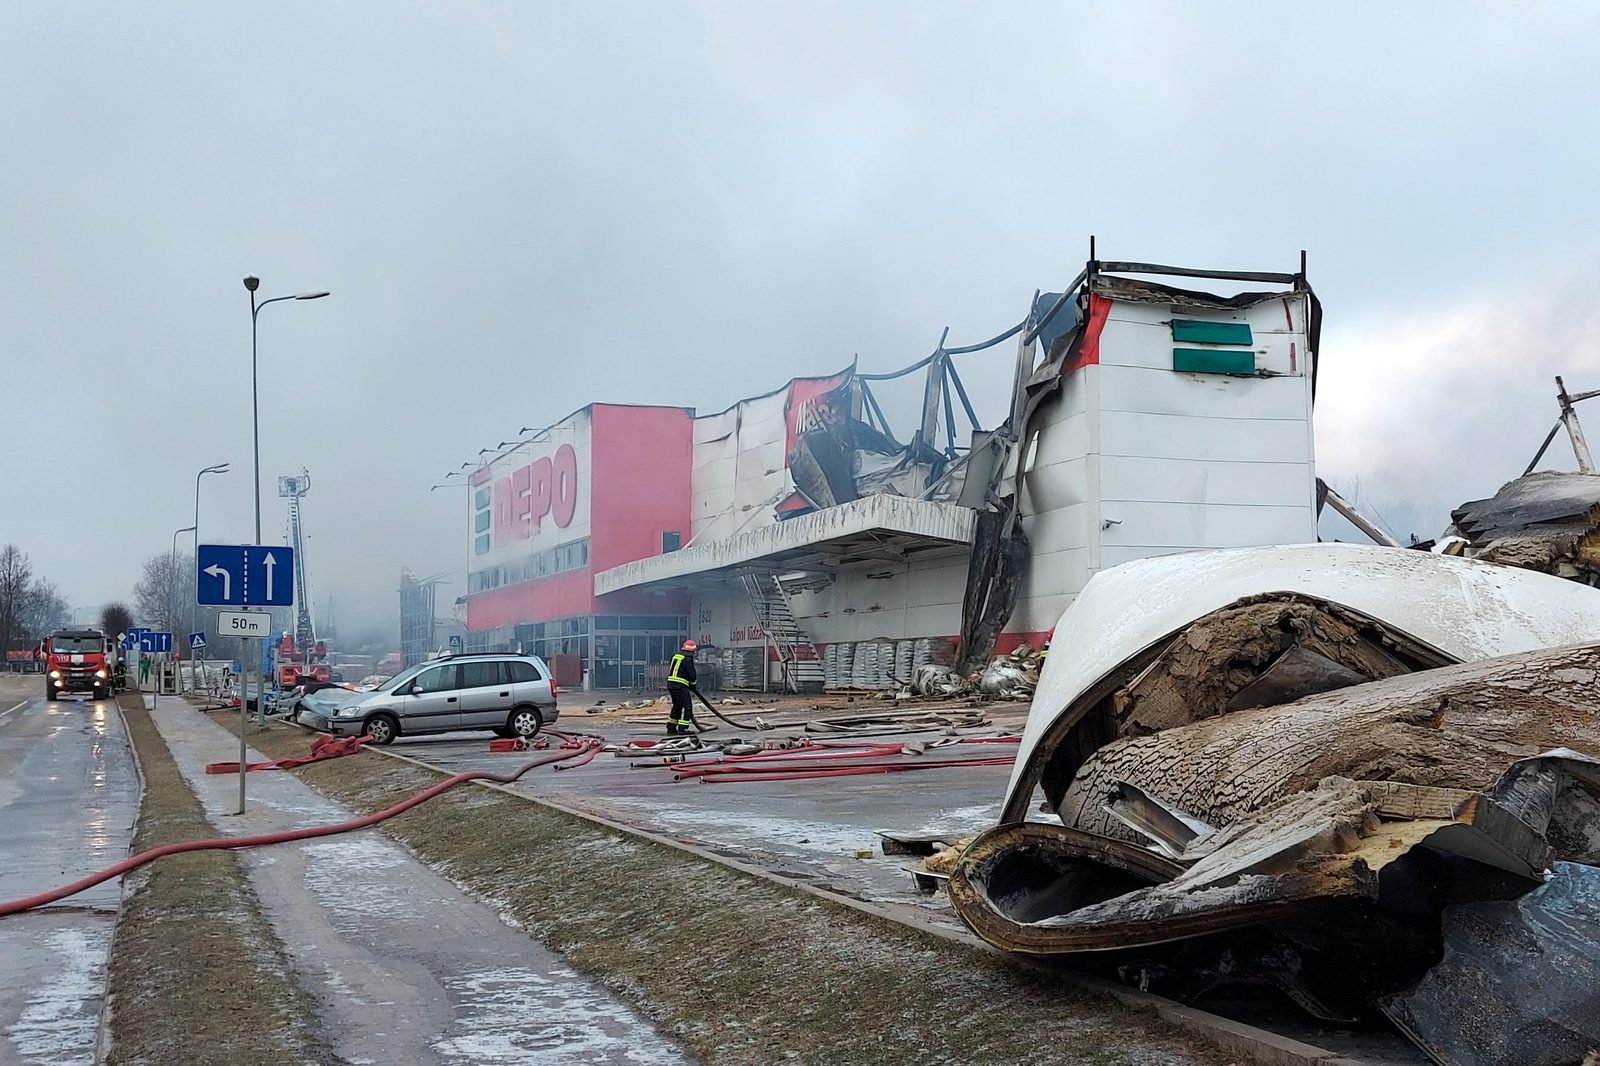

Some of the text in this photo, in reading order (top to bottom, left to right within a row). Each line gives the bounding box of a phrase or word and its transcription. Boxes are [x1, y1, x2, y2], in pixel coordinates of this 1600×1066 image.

[493, 442, 578, 550] DEPO
[231, 617, 259, 631] 50 m
